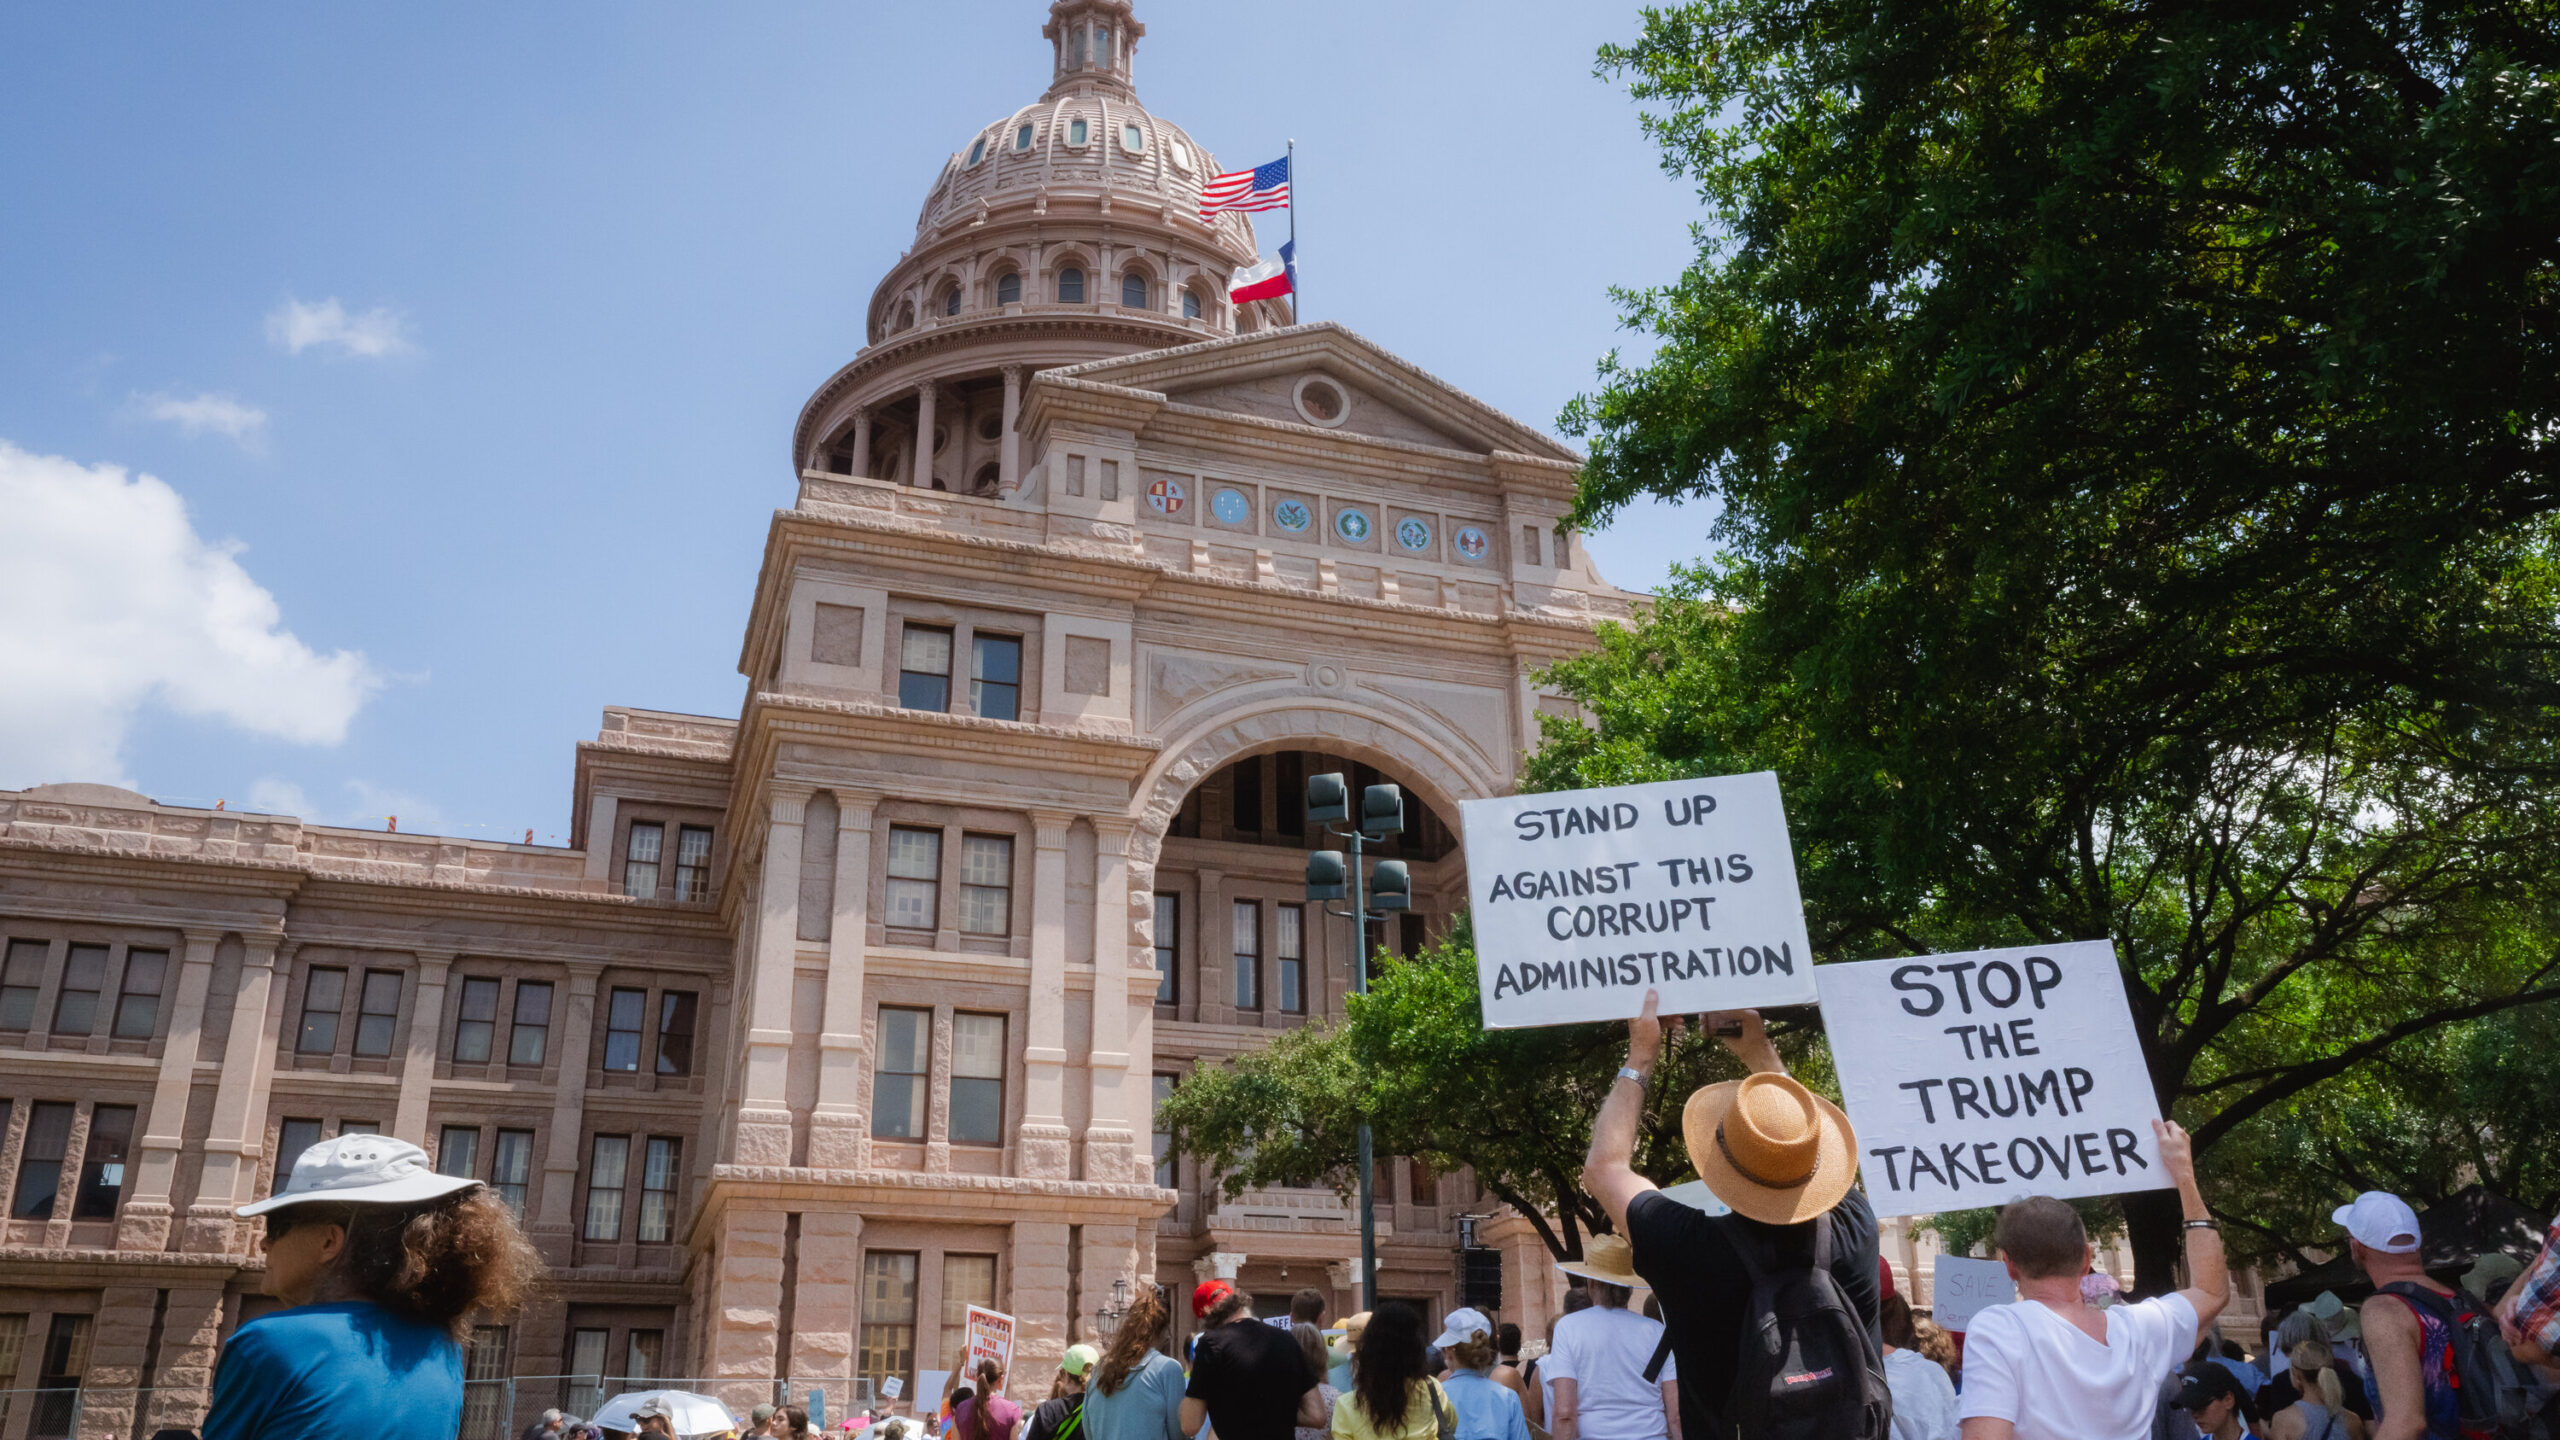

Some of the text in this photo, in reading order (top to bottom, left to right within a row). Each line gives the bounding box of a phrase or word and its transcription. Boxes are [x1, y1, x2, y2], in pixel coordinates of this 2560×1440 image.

[1514, 795, 1717, 841] STAND UP
[1490, 854, 1753, 903] AGAINST THIS
[1547, 897, 1716, 940] CORRUPT
[1494, 941, 1793, 1000] ADMINISTRATION
[1891, 956, 2063, 1017] STOP
[1944, 1018, 2040, 1060] THE
[1899, 1067, 2094, 1124] TRUMP
[1870, 1128, 2148, 1192] TAKEOVER
[1950, 1273, 1998, 1298] SAVE
